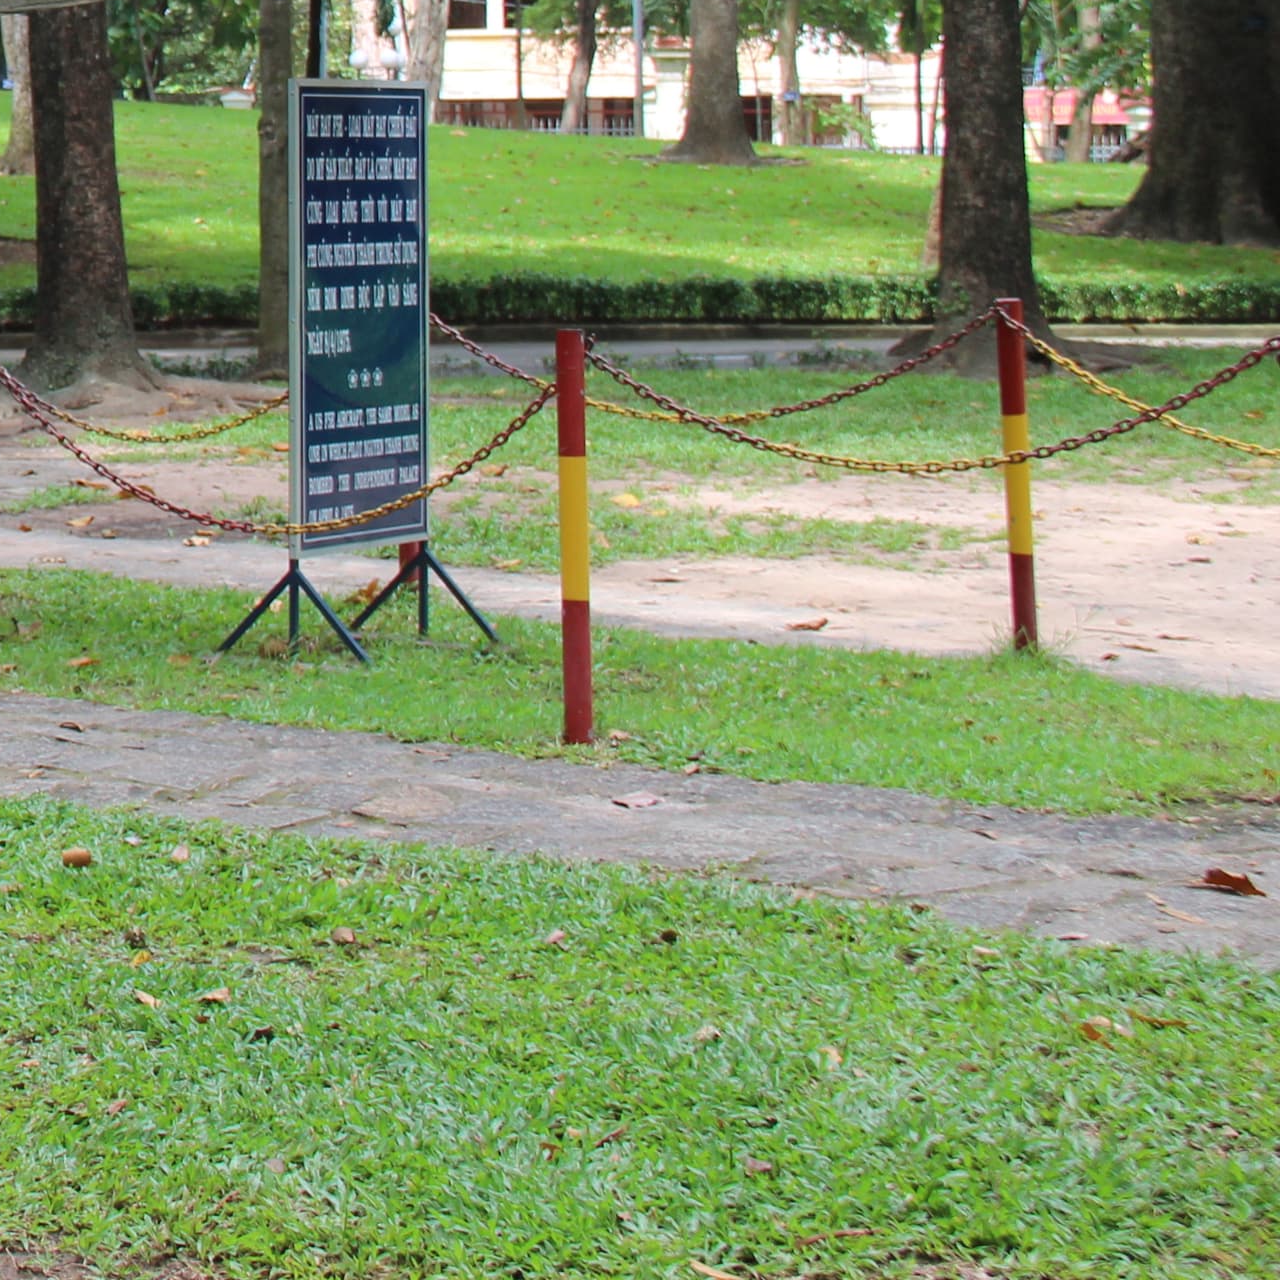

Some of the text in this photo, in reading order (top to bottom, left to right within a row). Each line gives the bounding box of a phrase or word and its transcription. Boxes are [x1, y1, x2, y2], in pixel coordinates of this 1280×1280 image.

[306, 108, 319, 138] MÁY
[320, 114, 331, 138] BAY
[362, 108, 374, 138] MÁY
[375, 114, 386, 138] BAY
[387, 104, 404, 138] CHIẾN
[306, 157, 315, 181] DO
[393, 152, 405, 181] MÁY
[406, 157, 417, 181] BAY
[390, 193, 403, 223] MÁY
[405, 199, 417, 222] BAY
[306, 244, 317, 268] PHI
[375, 242, 393, 265] TRUNG
[324, 286, 338, 311] BOM
[340, 285, 355, 309] DINH
[307, 324, 323, 355] NGÀY
[308, 412, 314, 431] A
[314, 412, 323, 431] US
[366, 406, 377, 426] THE
[378, 405, 393, 424] SAME
[393, 403, 411, 423] MODEL
[412, 402, 419, 421] AS
[308, 433, 419, 463] ONE IN WHICH PILOT NGUYEN THANH TRUNG
[308, 464, 419, 495] BOMBED THE INDEPENDENCE PALACE
